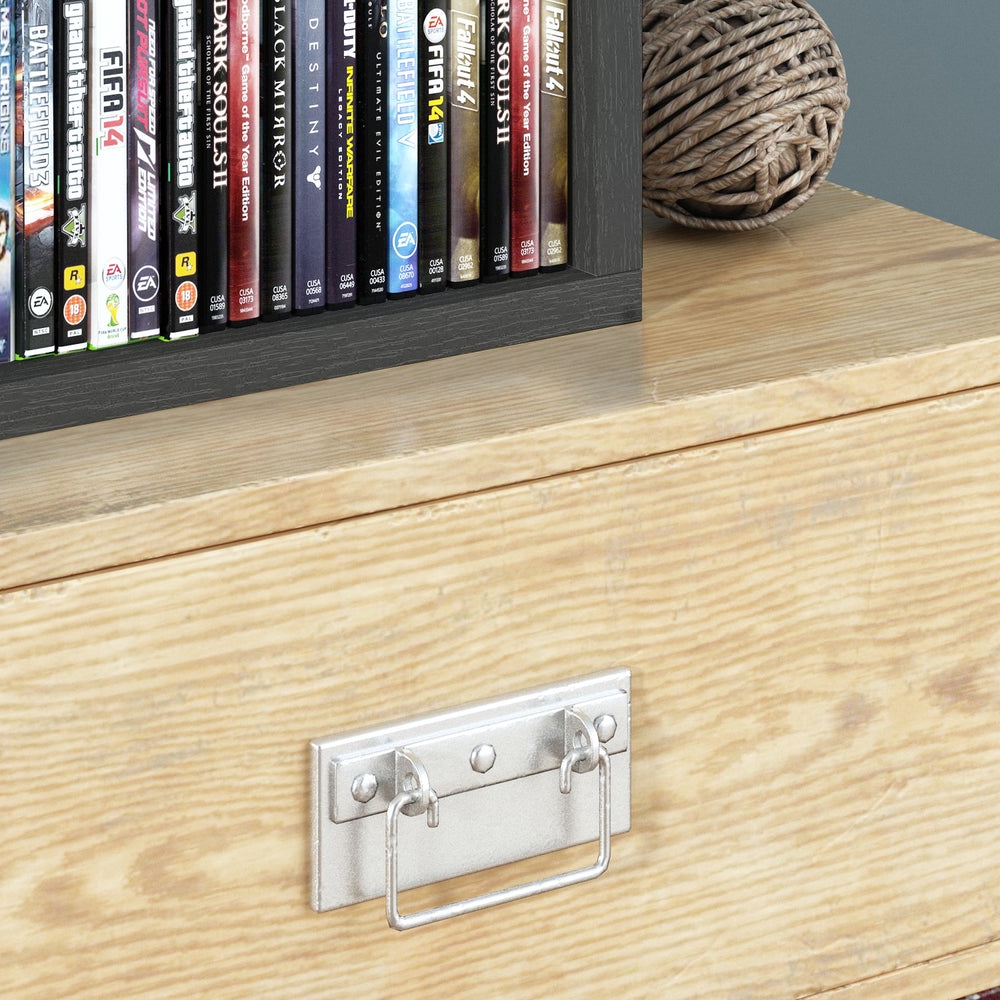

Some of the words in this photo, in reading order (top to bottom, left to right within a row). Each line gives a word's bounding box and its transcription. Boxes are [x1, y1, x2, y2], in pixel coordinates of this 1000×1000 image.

[428, 16, 444, 29] EA
[64, 2, 87, 71] grand
[343, 10, 356, 59] DUTY
[522, 25, 531, 61] Game
[545, 5, 564, 76] Fallout
[456, 18, 476, 89] Fallout
[428, 44, 444, 94] FIFA
[522, 64, 531, 76] of
[103, 50, 124, 113] FIFA
[136, 30, 149, 131] PURSUIT
[241, 63, 250, 103] Game
[308, 18, 319, 156] DESTINY
[496, 42, 510, 124] SOULS
[522, 79, 531, 100] the
[545, 76, 564, 92] 4
[28, 25, 50, 170] BATTLEFIELD
[346, 65, 354, 134] INFINITE
[456, 89, 476, 105] 4
[0, 62, 11, 155] ORIGINS
[241, 106, 250, 118] of
[428, 96, 444, 121] 14
[522, 102, 531, 131] Year
[103, 115, 124, 147] 14
[213, 81, 228, 166] SOULS
[241, 121, 250, 142] the
[397, 128, 417, 149] V
[496, 127, 510, 144] II
[177, 131, 194, 188] auto
[241, 144, 250, 174] Year
[522, 133, 531, 176] Edition
[29, 171, 50, 188] 3
[66, 143, 84, 200] auto
[213, 170, 228, 189] II
[346, 136, 354, 219] WARFARE
[137, 166, 147, 232] EDITION
[147, 170, 156, 241] LIMITED
[241, 176, 250, 222] Edition
[397, 232, 416, 248] EA
[494, 246, 508, 255] CUSA
[521, 239, 535, 248] CUSA
[548, 239, 561, 248] CUSA
[180, 256, 190, 268] R
[399, 264, 414, 273] CUSA
[429, 258, 444, 267] CUSA
[458, 255, 473, 263] CUSA
[69, 269, 79, 281] R
[106, 264, 122, 276] EA
[340, 273, 354, 282] CUSA
[370, 268, 385, 277] CUSA
[137, 276, 157, 292] EA
[239, 288, 254, 297] CUSA
[272, 285, 287, 294] CUSA
[306, 279, 321, 288] CUSA
[33, 296, 49, 307] EA
[181, 290, 191, 303] 18
[210, 295, 225, 303] CUSA
[69, 303, 80, 316] 18
